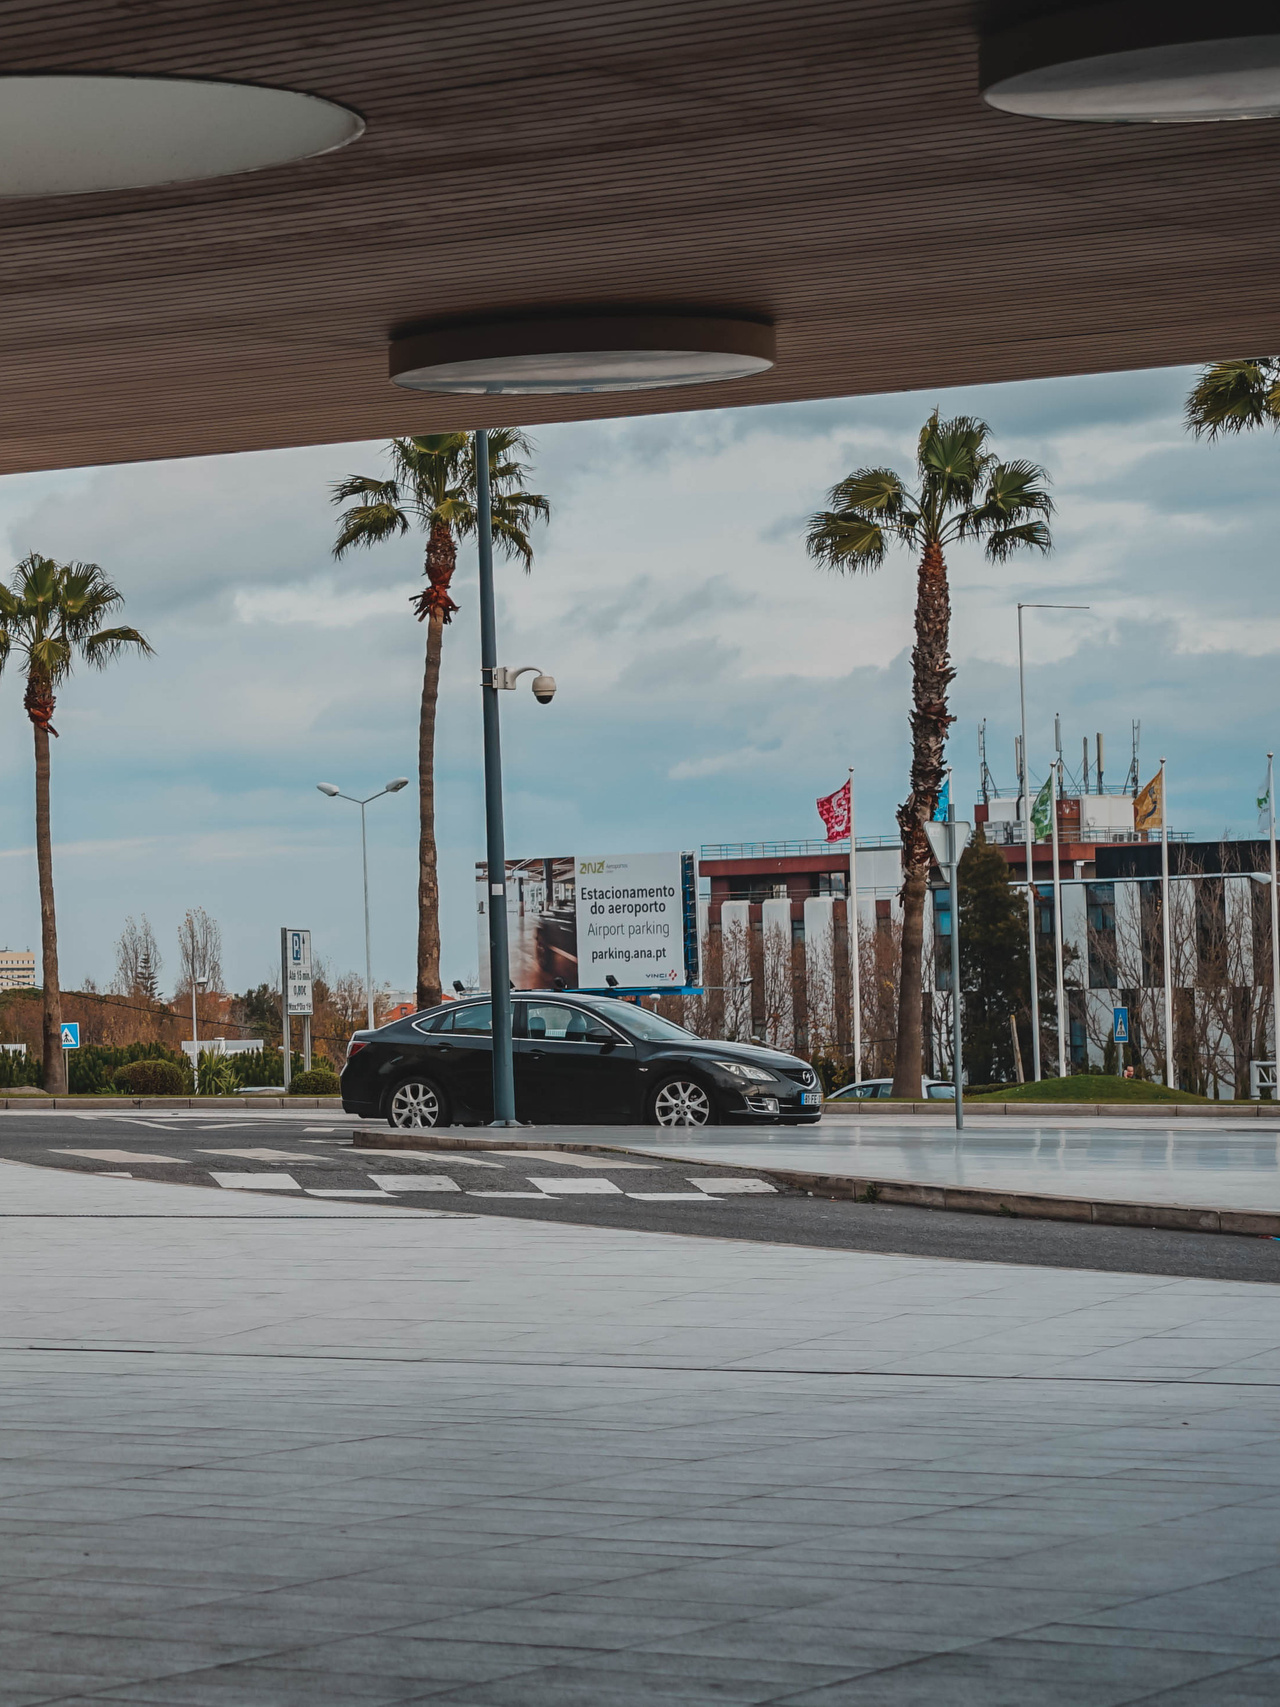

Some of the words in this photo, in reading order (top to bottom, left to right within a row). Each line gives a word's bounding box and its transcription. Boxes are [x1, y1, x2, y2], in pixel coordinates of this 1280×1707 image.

[581, 885, 675, 900] Estacionamento
[590, 901, 605, 915] do
[608, 901, 666, 917] aeroporto
[587, 923, 625, 939] Airport
[628, 920, 670, 938] parking
[591, 947, 666, 963] parking.ana.pt
